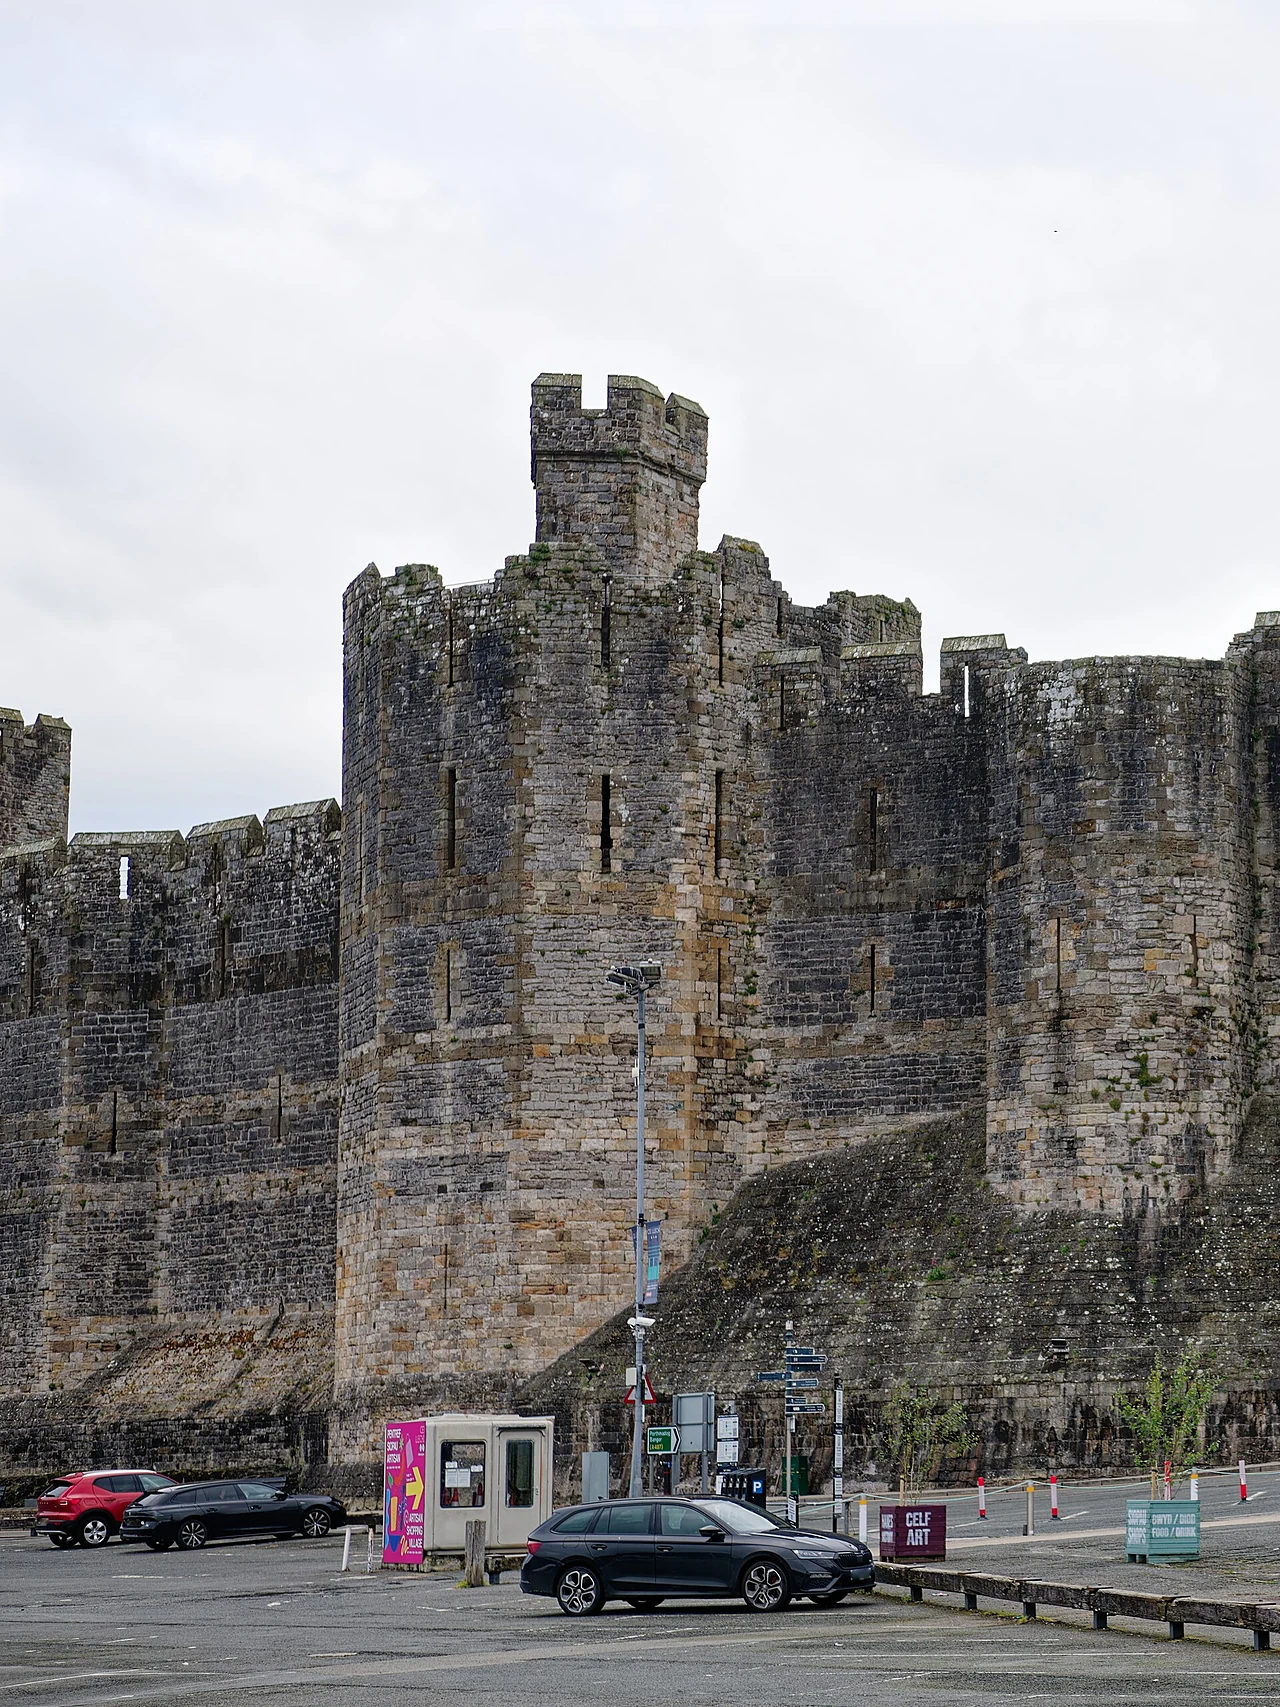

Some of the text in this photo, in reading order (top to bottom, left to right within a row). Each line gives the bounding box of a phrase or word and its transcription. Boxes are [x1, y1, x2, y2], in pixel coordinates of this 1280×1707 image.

[753, 1482, 762, 1492] P
[906, 1511, 932, 1527] CELF
[1128, 1509, 1147, 1525] SIOPAU
[1173, 1514, 1179, 1525] /
[906, 1528, 931, 1546] ART
[1128, 1527, 1147, 1544] SHOPS
[1152, 1528, 1169, 1538] FOOD
[1170, 1527, 1175, 1538] /
